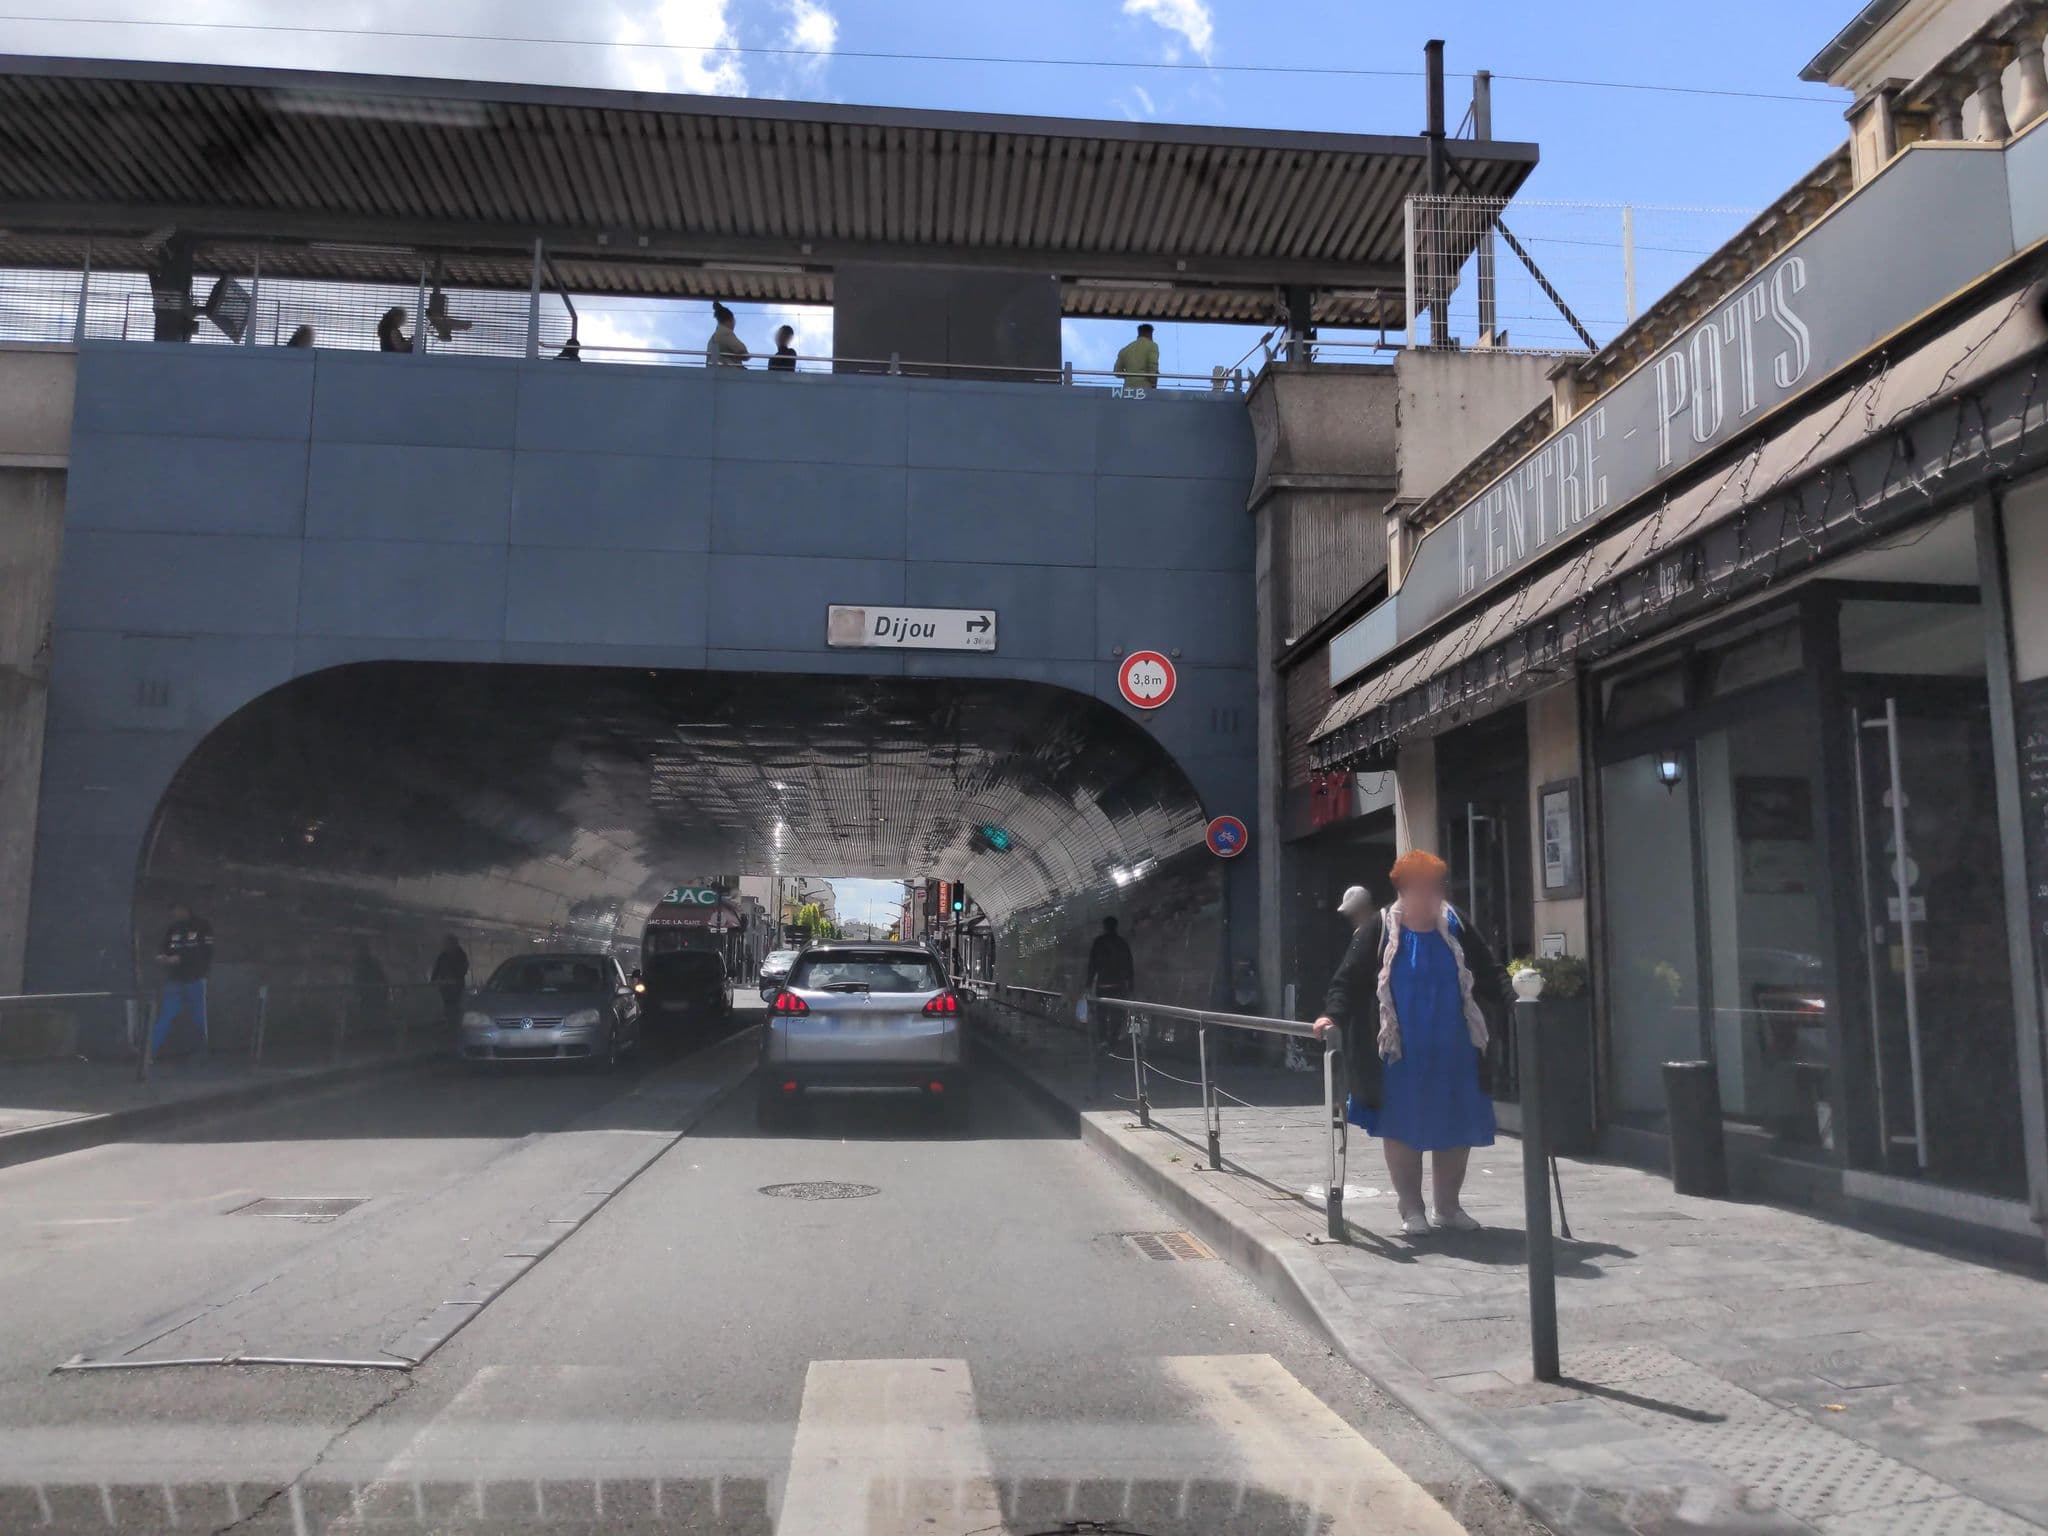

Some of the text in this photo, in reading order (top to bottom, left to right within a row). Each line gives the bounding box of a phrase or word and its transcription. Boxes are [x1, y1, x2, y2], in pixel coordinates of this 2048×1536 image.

[1111, 386, 1146, 400] WIB
[1456, 406, 1608, 599] L'ENTRE
[1653, 256, 1811, 472] POTS
[874, 615, 936, 643] Dijou
